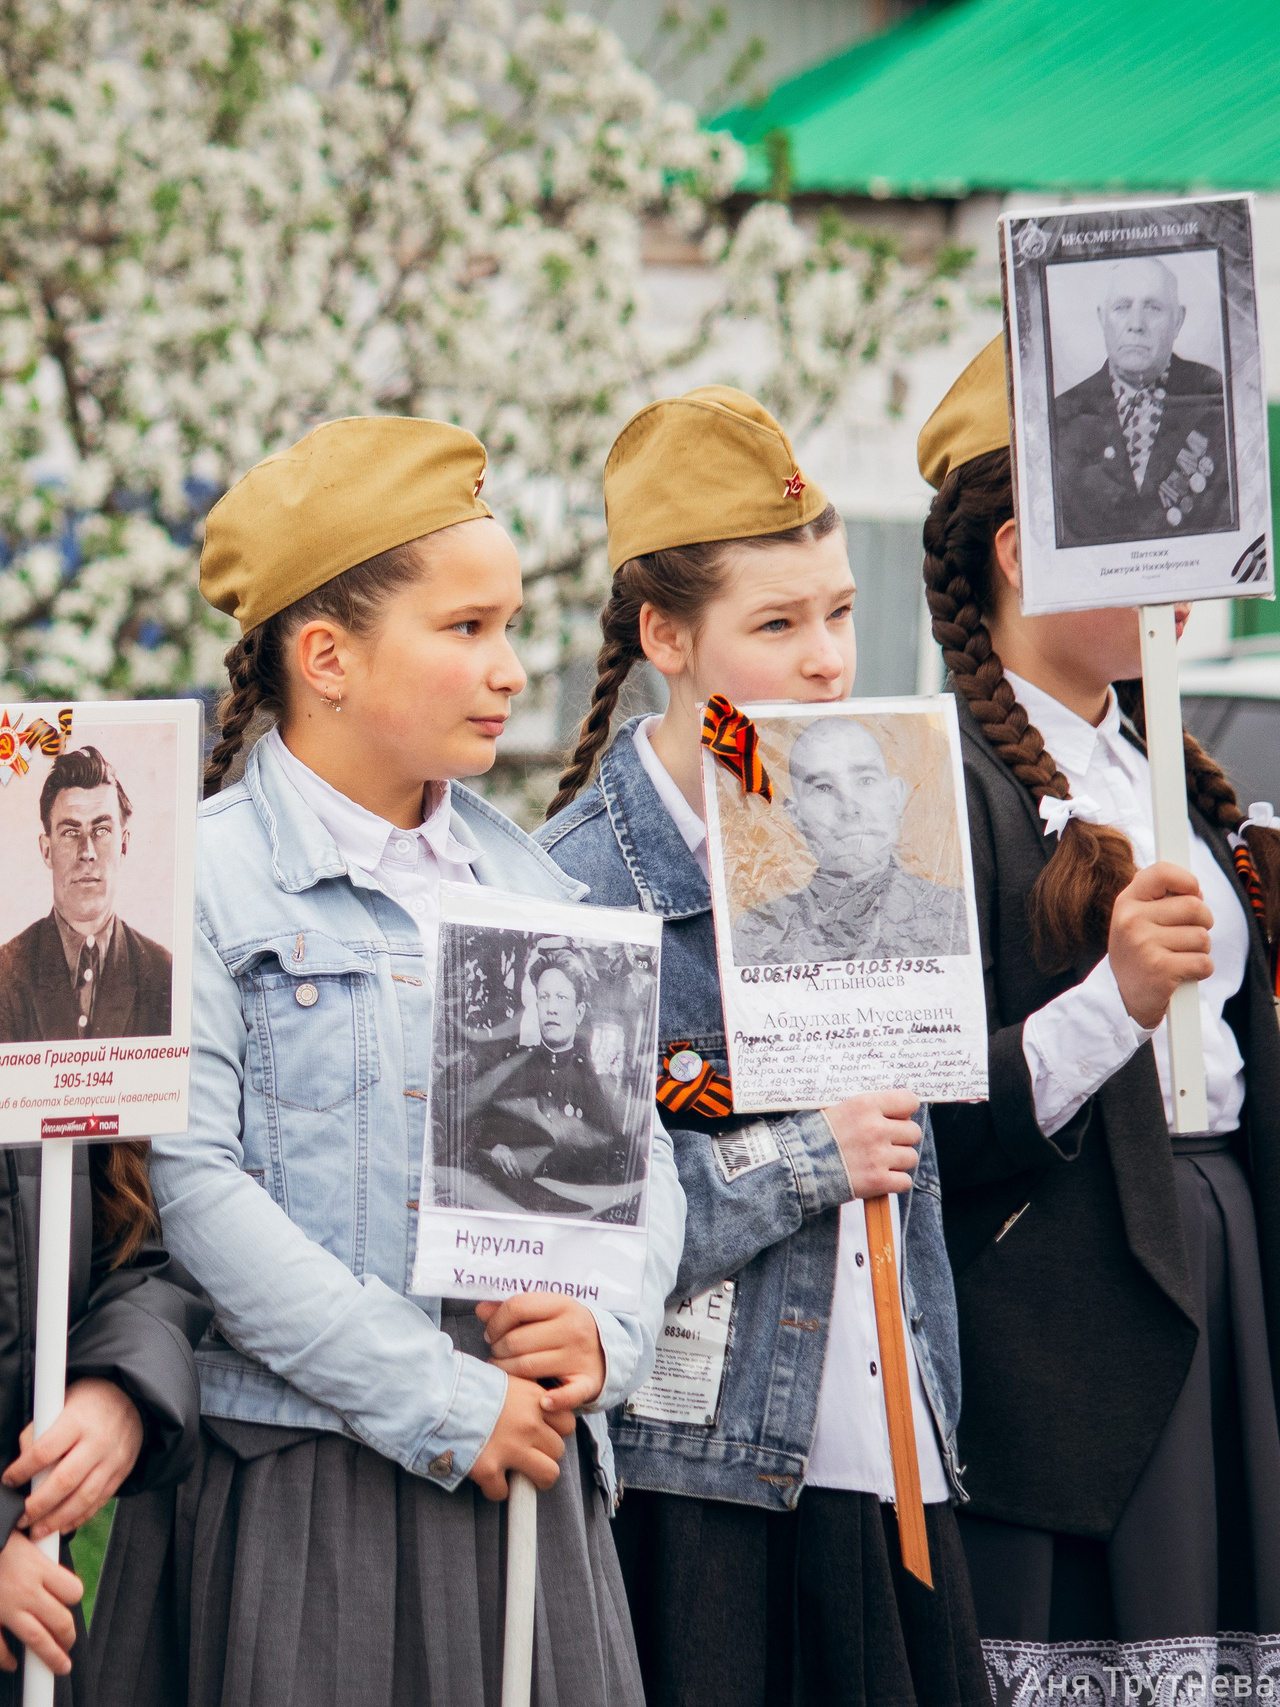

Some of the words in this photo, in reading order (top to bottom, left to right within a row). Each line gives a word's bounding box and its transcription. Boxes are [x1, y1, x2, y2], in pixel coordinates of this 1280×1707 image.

[1062, 223, 1158, 247] БЕССМЕРТНЫЙ
[1161, 221, 1199, 237] ПОЛК
[1100, 563, 1140, 576] Дмитрий
[1142, 559, 1200, 571] Никифорович
[805, 973, 905, 991] Алтынбаев
[763, 1011, 851, 1032] Абдулхак
[856, 1007, 954, 1027] Муссаевич
[45, 1046, 106, 1068] Григорий
[109, 1046, 190, 1061] Николаевич
[53, 1071, 114, 1088] 1905-1944
[12, 1100, 18, 1108] в
[20, 1096, 61, 1108] болотах
[63, 1094, 116, 1107] Белоруссии
[118, 1089, 181, 1105] (кавалерист)
[455, 1229, 544, 1256] Нурулла
